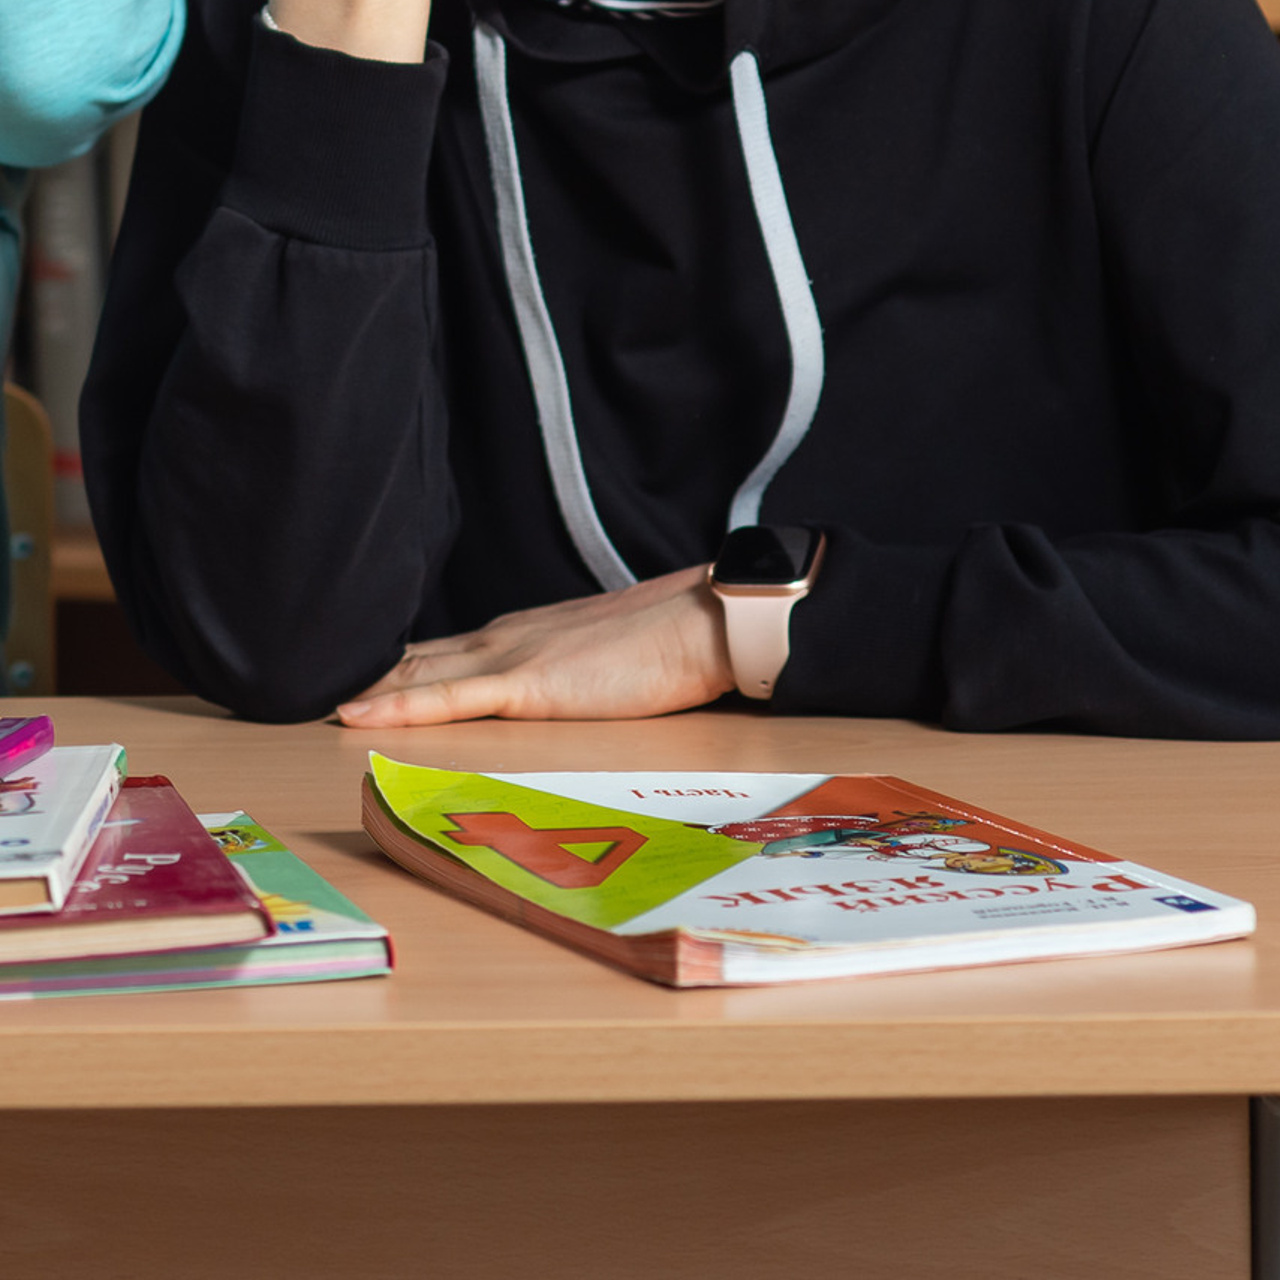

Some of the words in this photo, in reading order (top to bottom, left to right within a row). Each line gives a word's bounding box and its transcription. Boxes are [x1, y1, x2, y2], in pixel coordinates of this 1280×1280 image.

[653, 789, 751, 798] Часть
[437, 810, 650, 890] 4
[827, 874, 1159, 913] Русский
